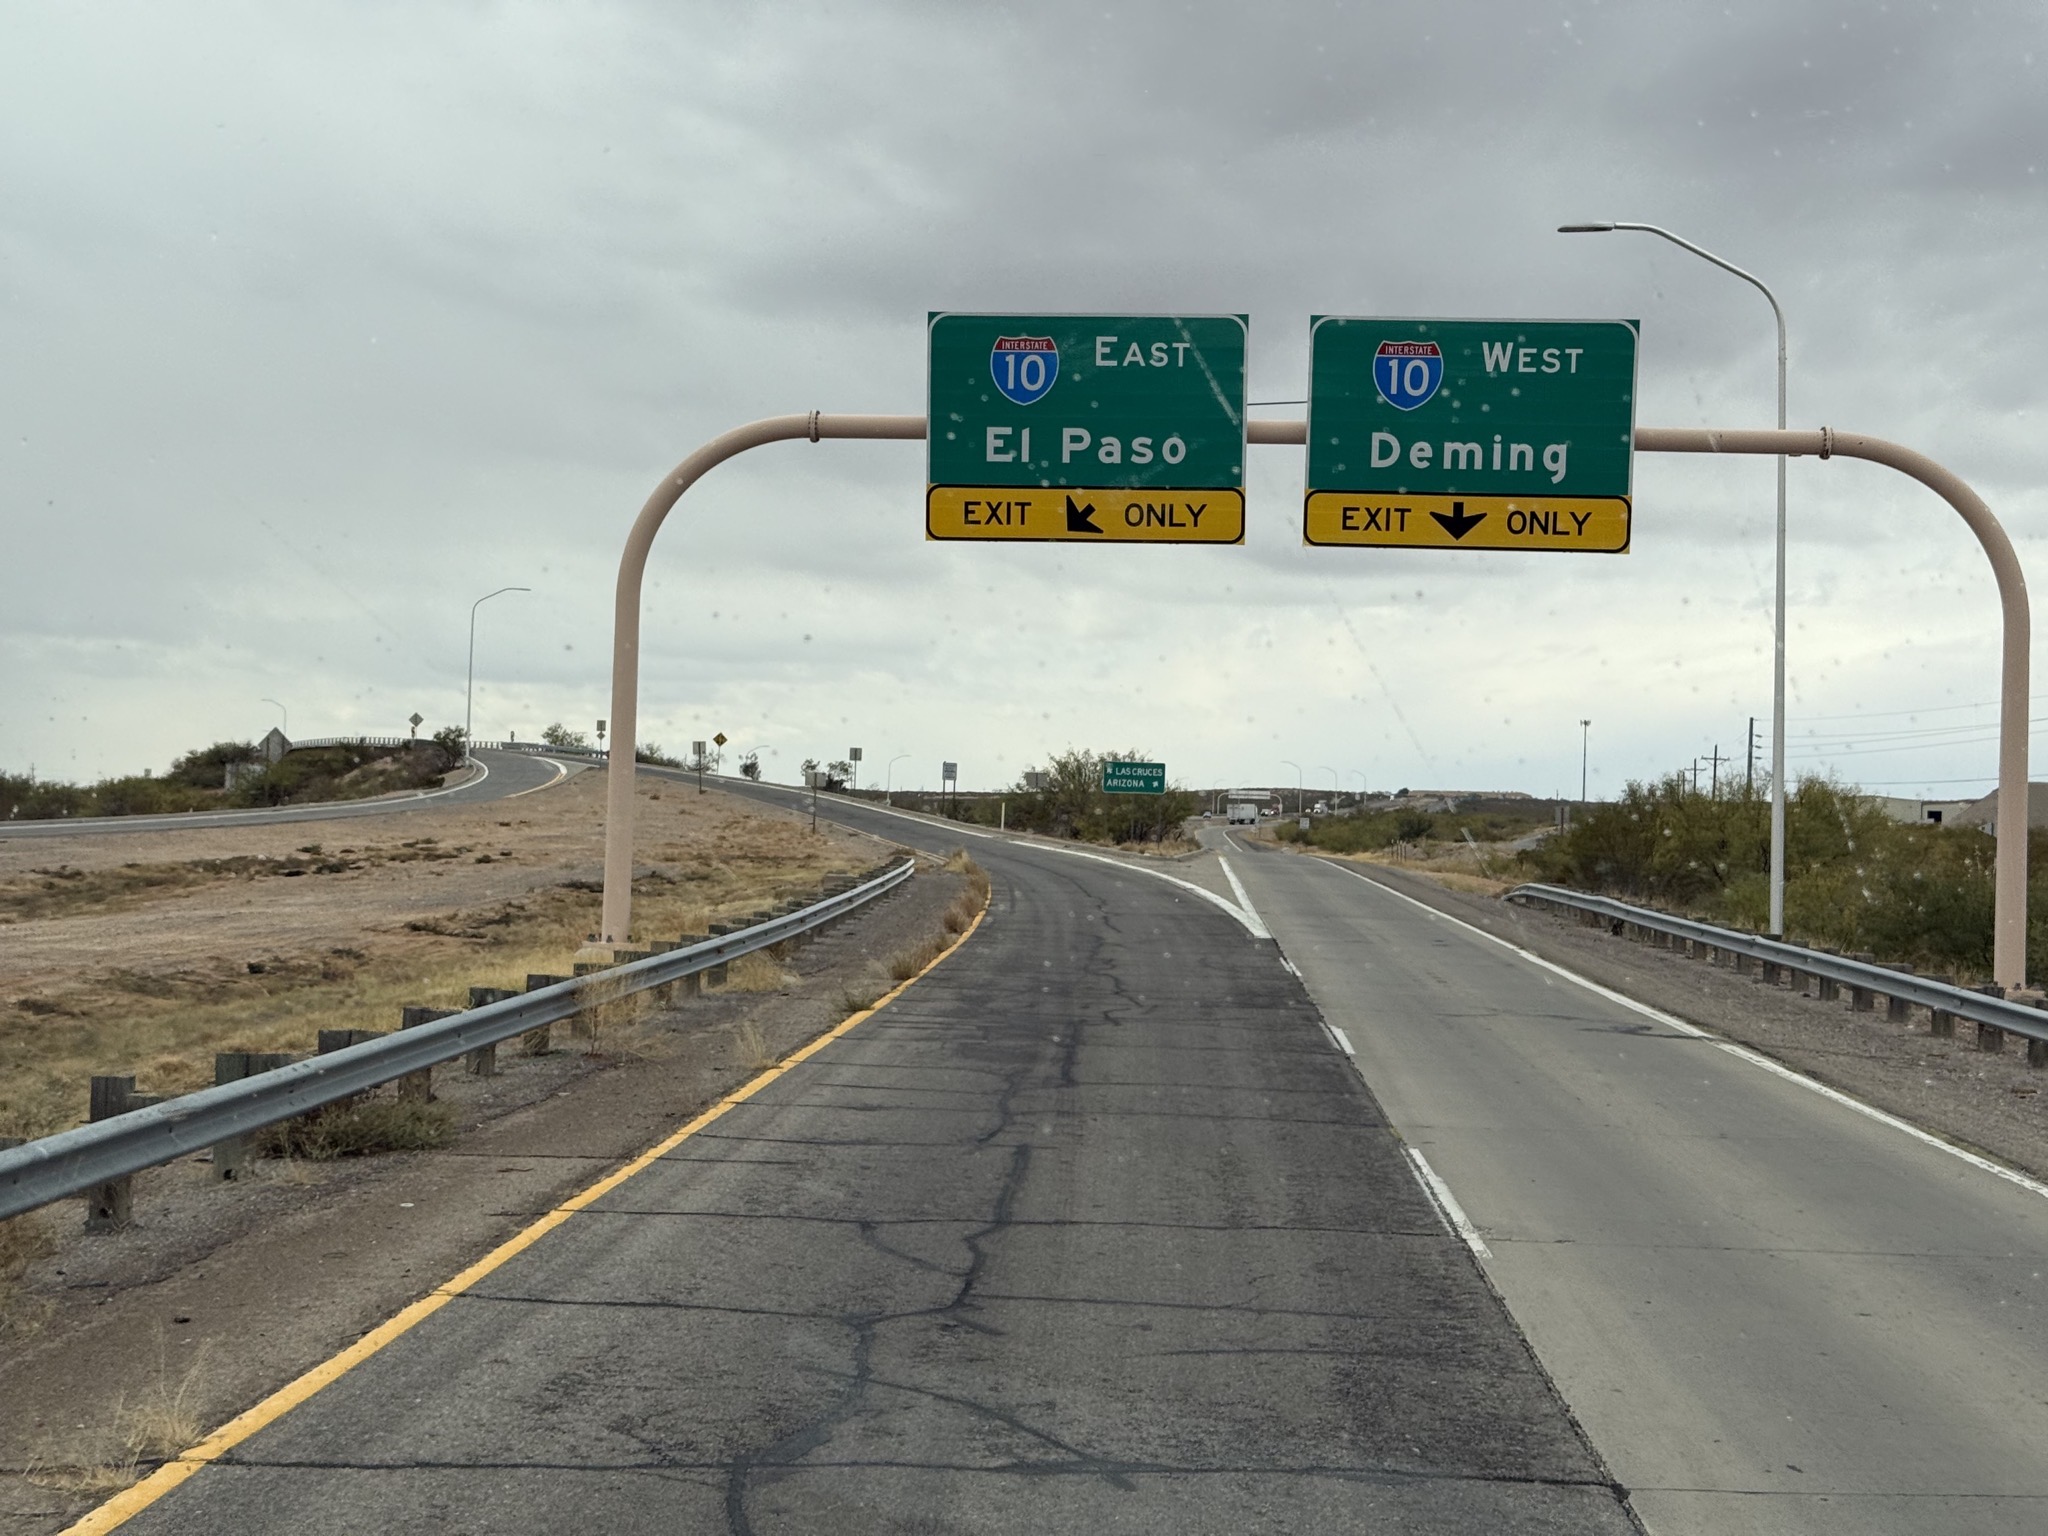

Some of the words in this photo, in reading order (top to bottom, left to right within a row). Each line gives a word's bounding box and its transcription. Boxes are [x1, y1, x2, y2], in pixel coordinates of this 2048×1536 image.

[1002, 340, 1048, 350] INTERSTATE
[1095, 336, 1190, 368] EAST
[1385, 345, 1432, 355] INTERSTATE
[1482, 342, 1584, 374] WEST
[1005, 354, 1046, 391] 10
[1388, 358, 1430, 397] 10
[987, 427, 1030, 464] El
[1062, 428, 1187, 465] Paso
[1370, 432, 1569, 485] Deming
[963, 502, 1031, 526] EXIT
[1124, 504, 1208, 528] ONLY
[1341, 507, 1411, 532] EXIT
[1507, 511, 1592, 536] ONLY
[1106, 779, 1145, 787] ARIZONA
[1132, 768, 1163, 776] CRUCES
